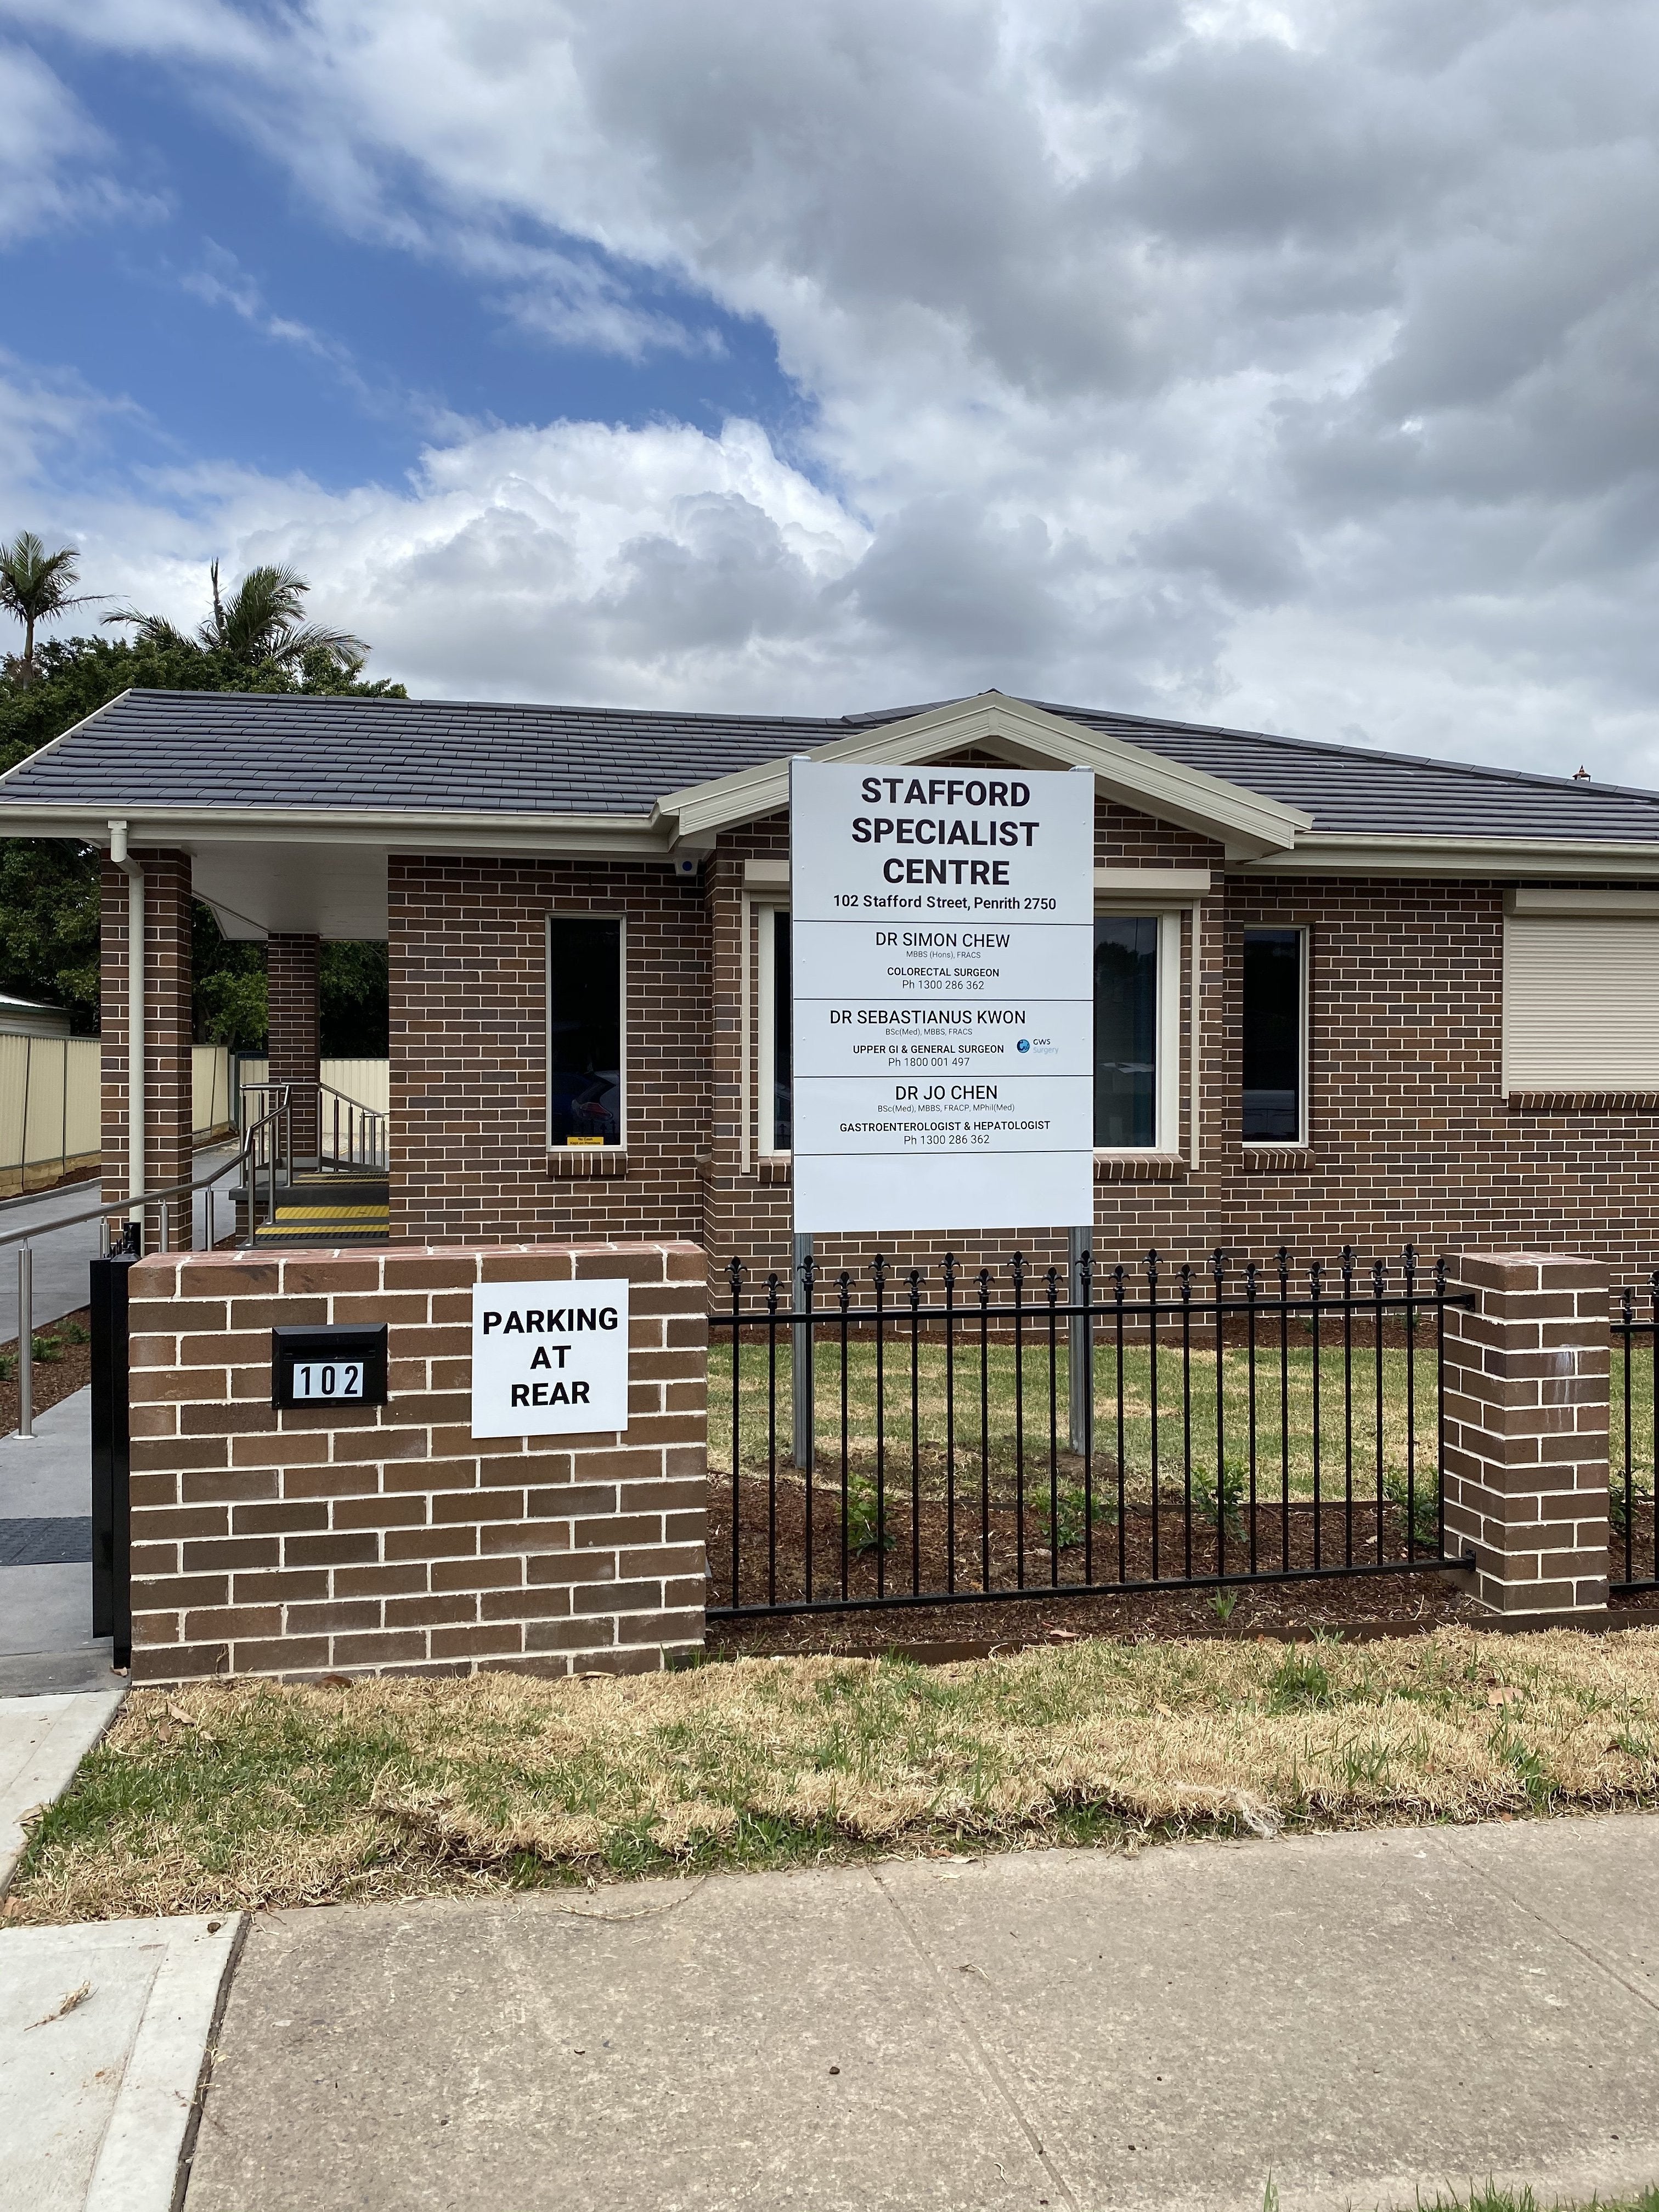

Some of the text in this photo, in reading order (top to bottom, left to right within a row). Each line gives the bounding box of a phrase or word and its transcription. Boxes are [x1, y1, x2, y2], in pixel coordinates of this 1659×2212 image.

[861, 777, 1030, 806] STAFFORD
[852, 817, 1039, 846] SPECIALIST
[884, 859, 1009, 885] CENTRE
[834, 895, 1056, 911] 102 Stafford Street, Penrith 2750
[877, 932, 1010, 947] DR SIMON CHEW
[930, 951, 955, 960] (Hons),
[888, 967, 999, 977] COLORECTAL SURGEON
[903, 980, 984, 989] Ph 1300 286 362
[831, 1011, 1025, 1024] DR SEBASTIANUS KWON
[886, 1028, 922, 1036] BSc(Med),
[889, 1045, 898, 1053] GI
[901, 1045, 907, 1053] &
[911, 1045, 955, 1053] GENERAL
[889, 1058, 969, 1066] Ph 1800 001 497
[896, 1085, 997, 1100] DR JO CHEN
[878, 1104, 916, 1113] BSc(Med),
[973, 1104, 1014, 1112] MPhil(Med)
[840, 1121, 1050, 1132] GASTROENTEROLOGIST & HEPATOLOGIST
[905, 1135, 989, 1144] Ph 1300 286 362
[484, 1307, 617, 1334] PARKING
[530, 1345, 571, 1369] AT
[301, 1365, 358, 1395] 102
[512, 1381, 590, 1407] REAR
